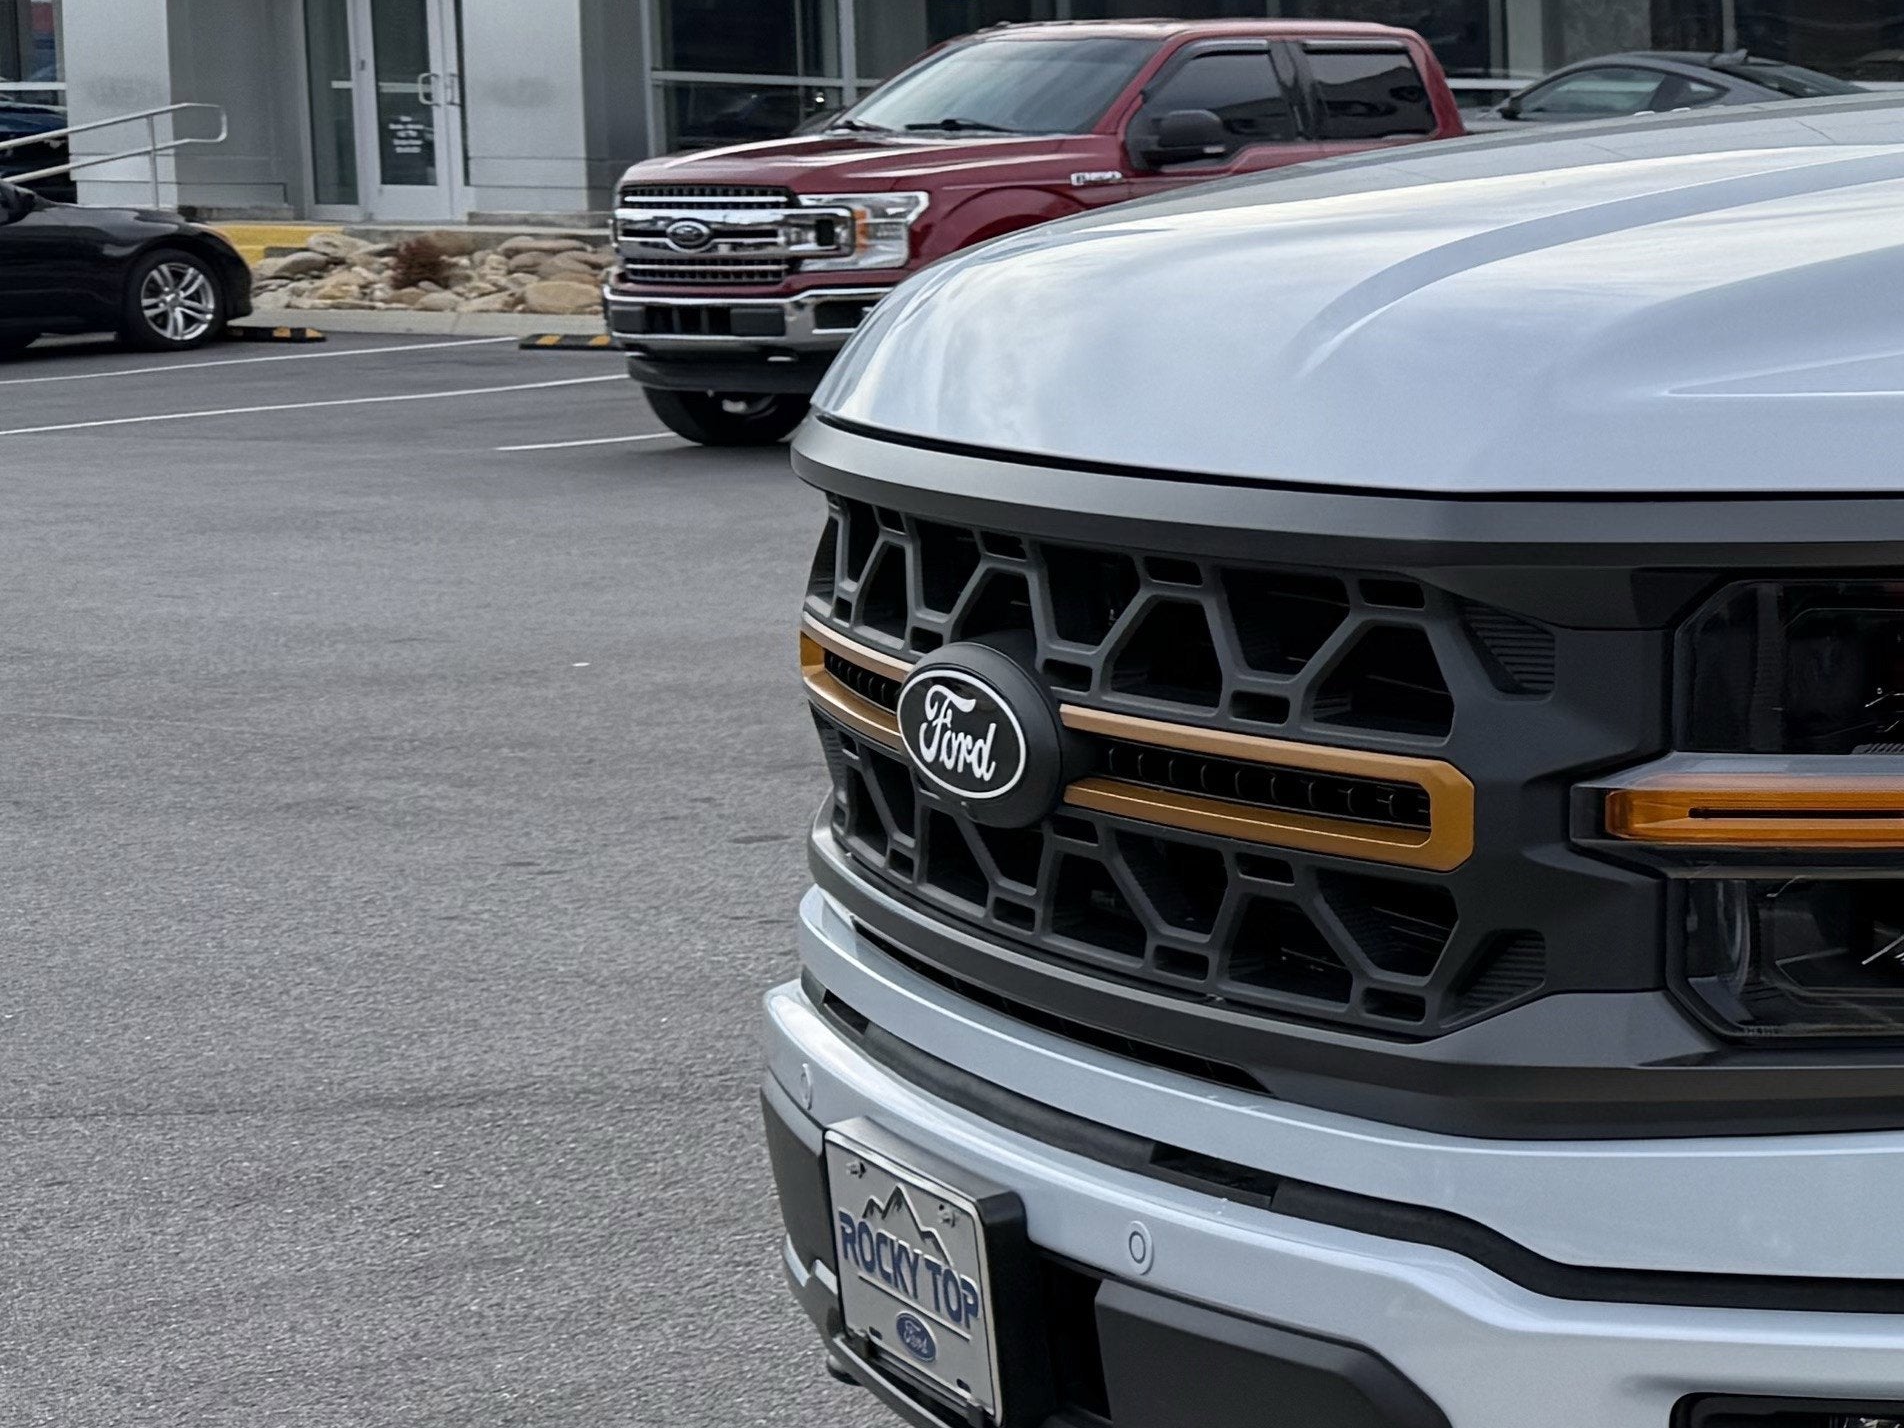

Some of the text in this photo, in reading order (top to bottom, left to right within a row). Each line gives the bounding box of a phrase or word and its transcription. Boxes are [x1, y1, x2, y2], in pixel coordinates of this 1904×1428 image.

[919, 684, 997, 781] Ford
[838, 1207, 980, 1329] ROCKY TOP
